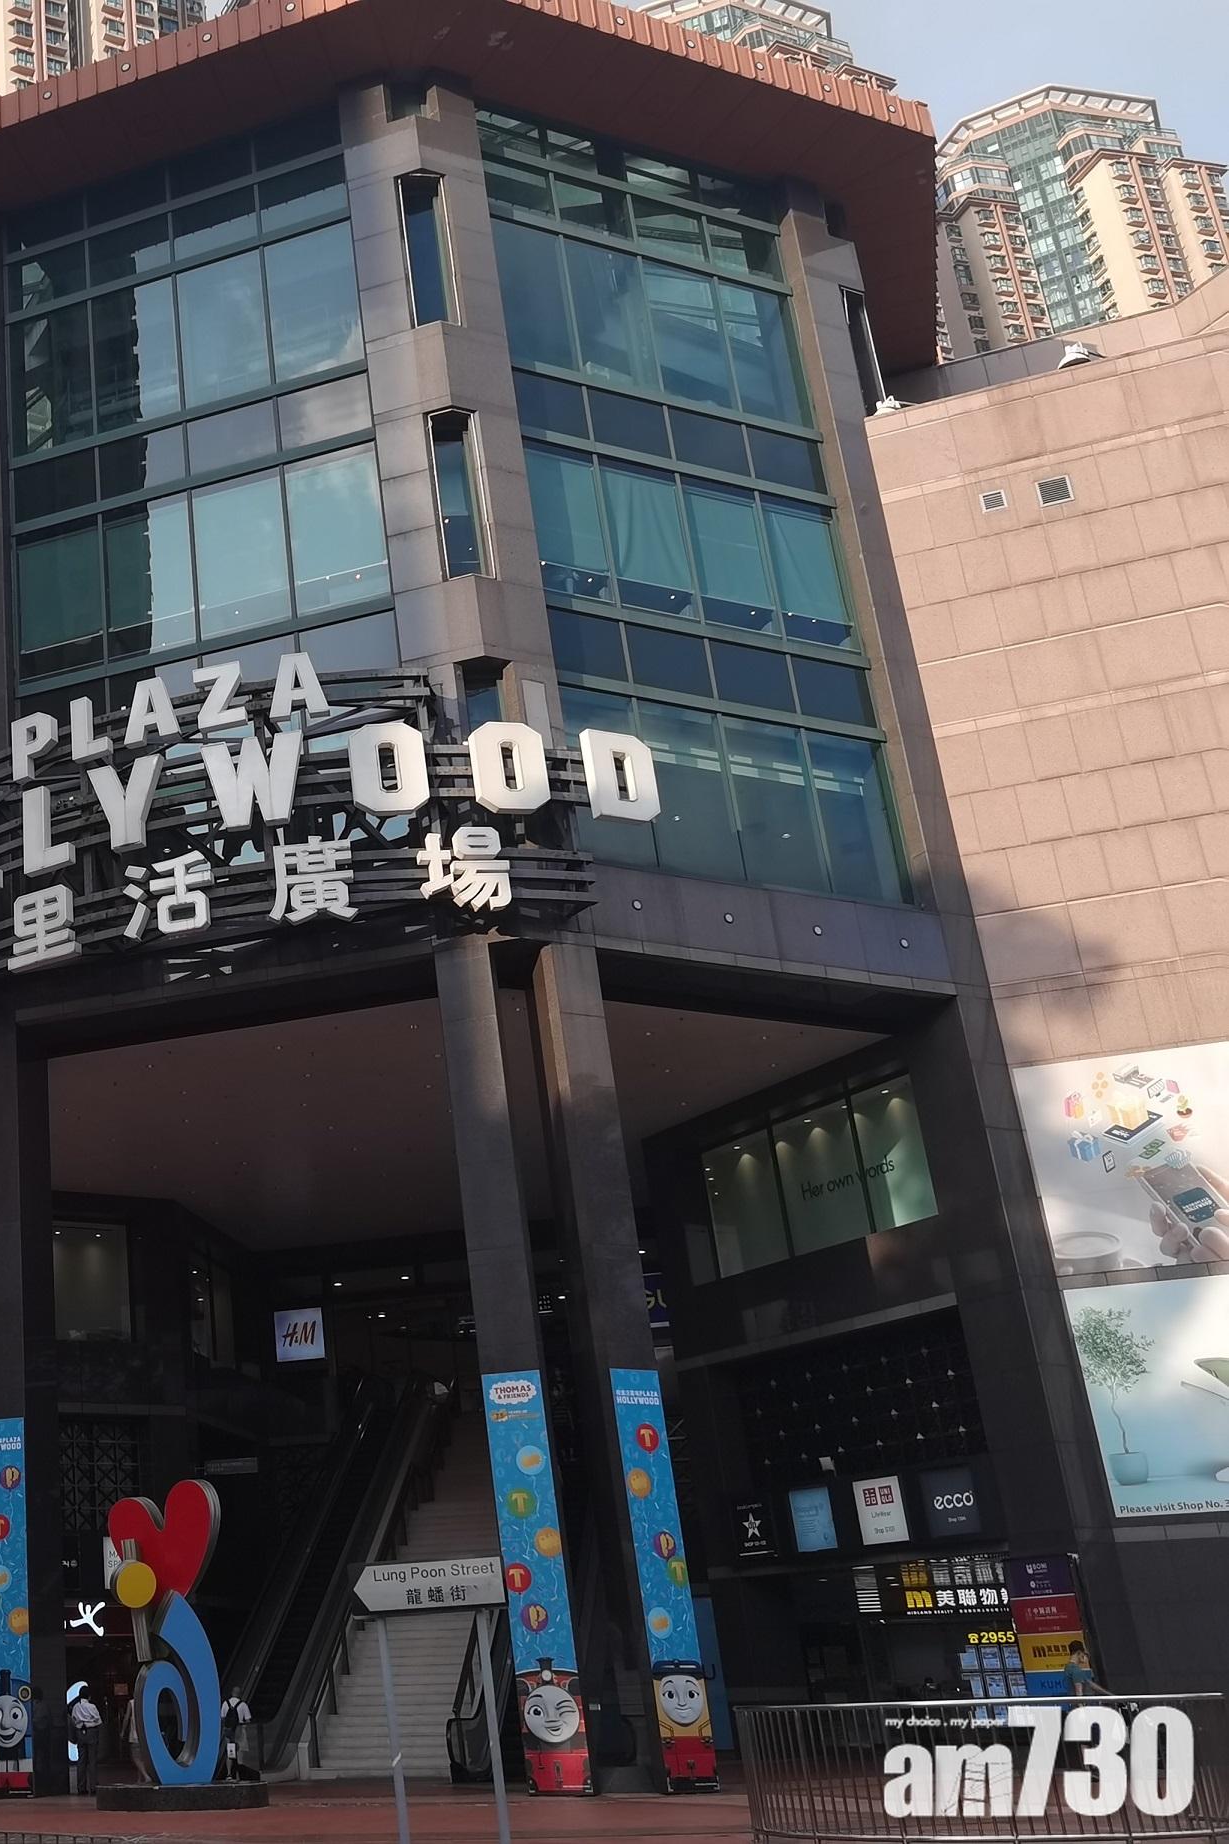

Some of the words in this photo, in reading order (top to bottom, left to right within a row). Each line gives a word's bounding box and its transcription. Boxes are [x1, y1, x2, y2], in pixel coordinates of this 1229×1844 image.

[11, 652, 333, 782] PLAZA
[801, 1182, 824, 1201] Her
[827, 1173, 854, 1193] own
[856, 1155, 896, 1184] words
[282, 1320, 317, 1348] H&M
[494, 1384, 532, 1394] THOMAS
[503, 1392, 530, 1400] FRIENDS
[616, 1396, 660, 1405] HOLLYWOOD
[933, 1491, 974, 1510] ecco
[1119, 1503, 1152, 1514] Please
[1154, 1501, 1176, 1511] visit
[1177, 1501, 1203, 1511] Shop
[1205, 1499, 1223, 1509] No.
[373, 1569, 406, 1583] Lung
[410, 1566, 446, 1580] Poon
[450, 1561, 496, 1577] Street
[405, 1585, 467, 1605] 龍蟠街
[980, 1631, 1016, 1643] 2955
